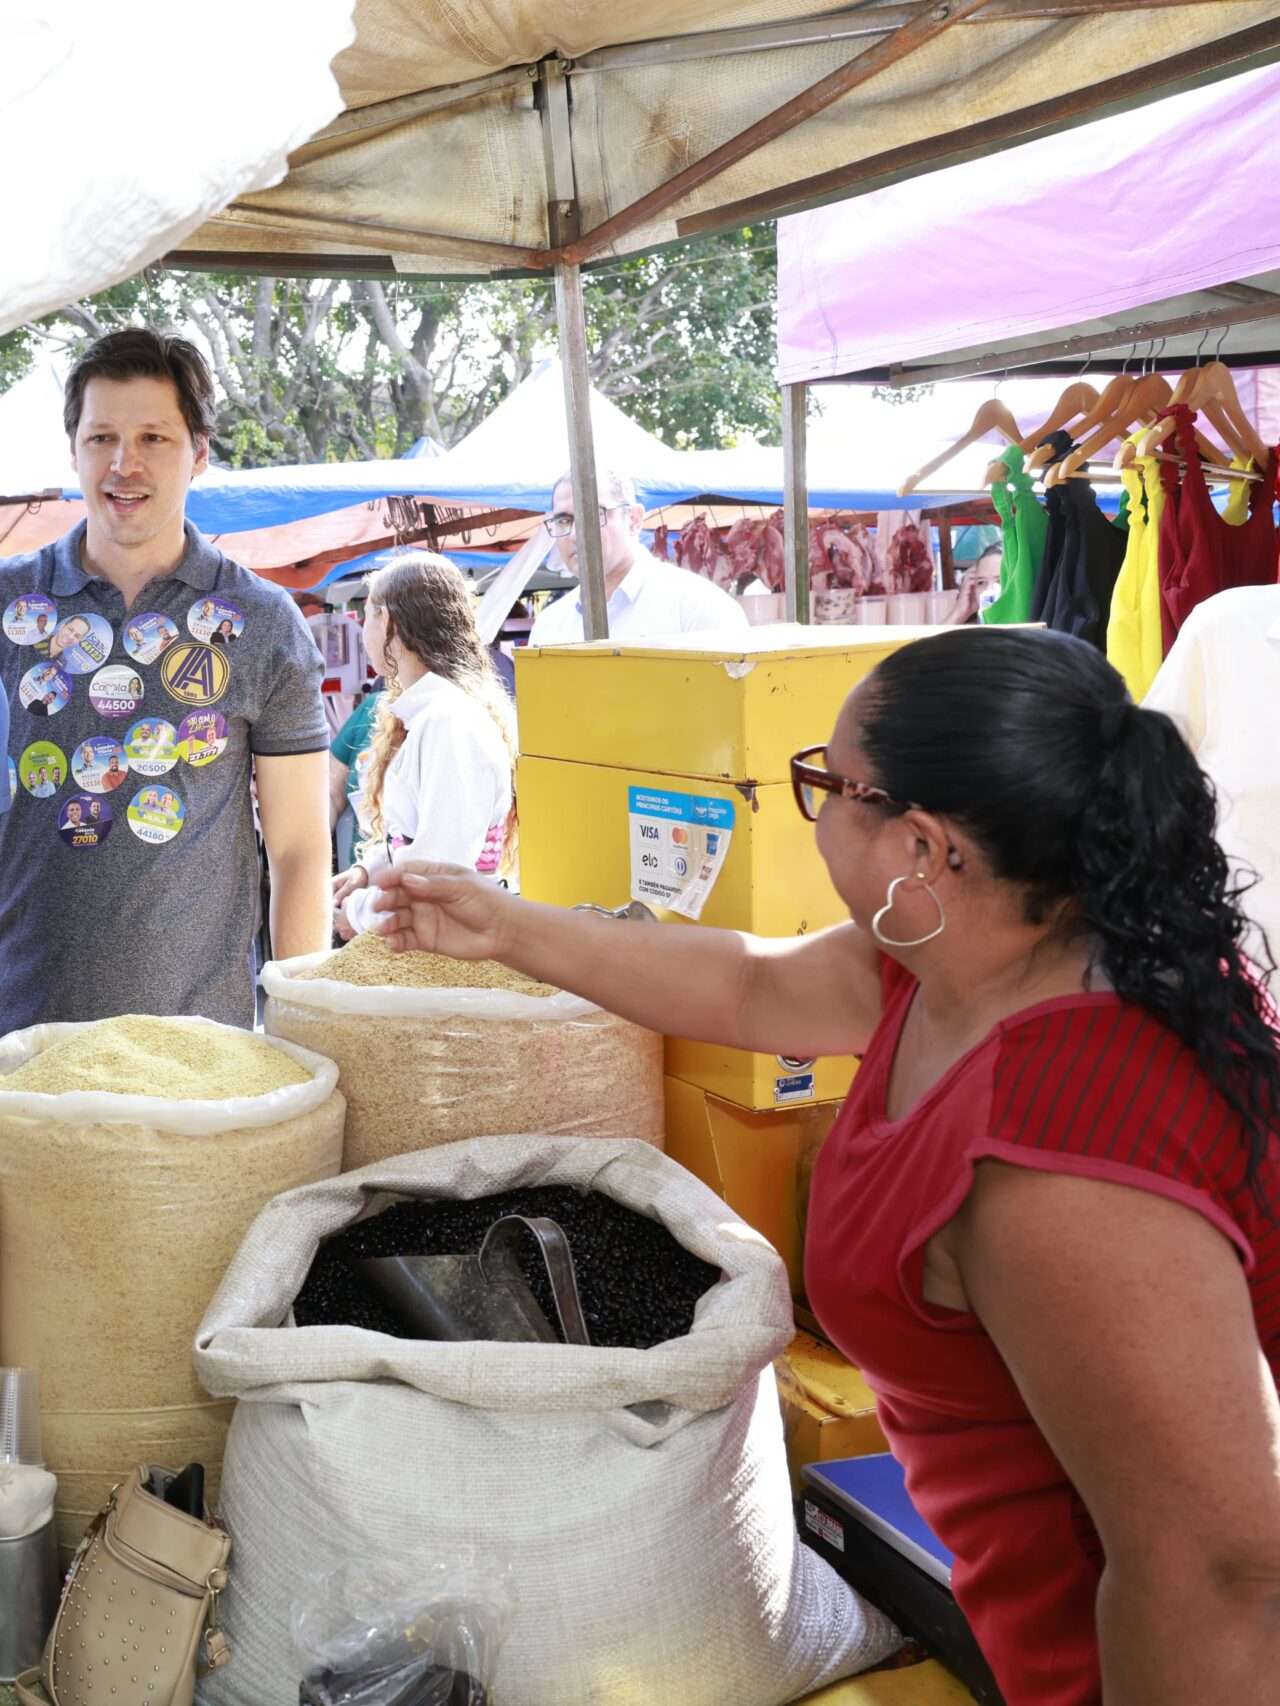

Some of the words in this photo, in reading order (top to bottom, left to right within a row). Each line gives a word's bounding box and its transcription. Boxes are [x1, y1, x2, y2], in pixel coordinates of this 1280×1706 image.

[81, 641, 103, 661] 44123
[92, 682, 127, 692] Camila
[97, 699, 136, 710] 44500
[136, 764, 167, 772] 20500
[136, 829, 165, 841] 44180
[639, 824, 660, 841] VISA
[72, 834, 98, 844] 27010
[642, 853, 658, 868] elo
[639, 885, 649, 893] COM
